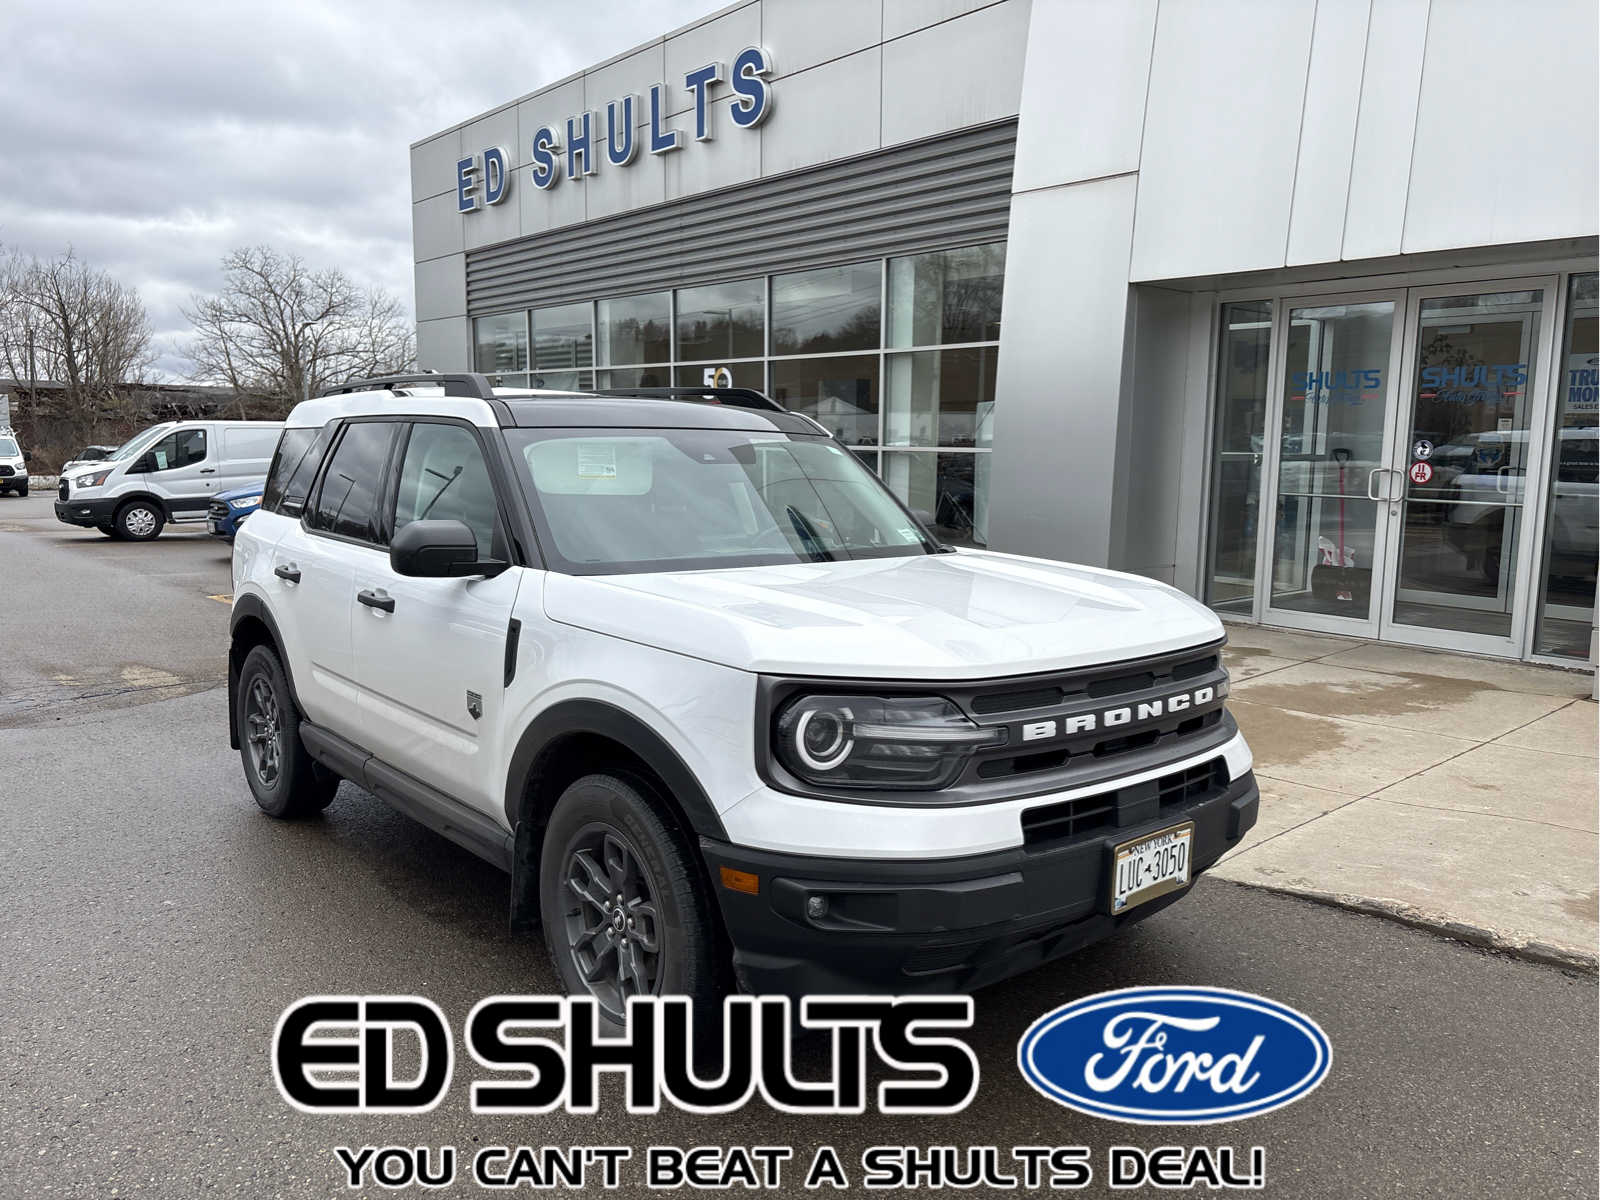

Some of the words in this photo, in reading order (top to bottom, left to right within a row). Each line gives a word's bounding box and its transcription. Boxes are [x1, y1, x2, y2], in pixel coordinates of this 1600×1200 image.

[457, 146, 511, 214] ED
[531, 45, 773, 190] SHULTS
[1292, 369, 1381, 391] SHULTS
[1421, 364, 1527, 388] SHULTS
[1415, 472, 1426, 481] FR
[1022, 686, 1214, 741] BRONCO
[1133, 842, 1151, 855] NEW
[1152, 835, 1174, 850] YORK
